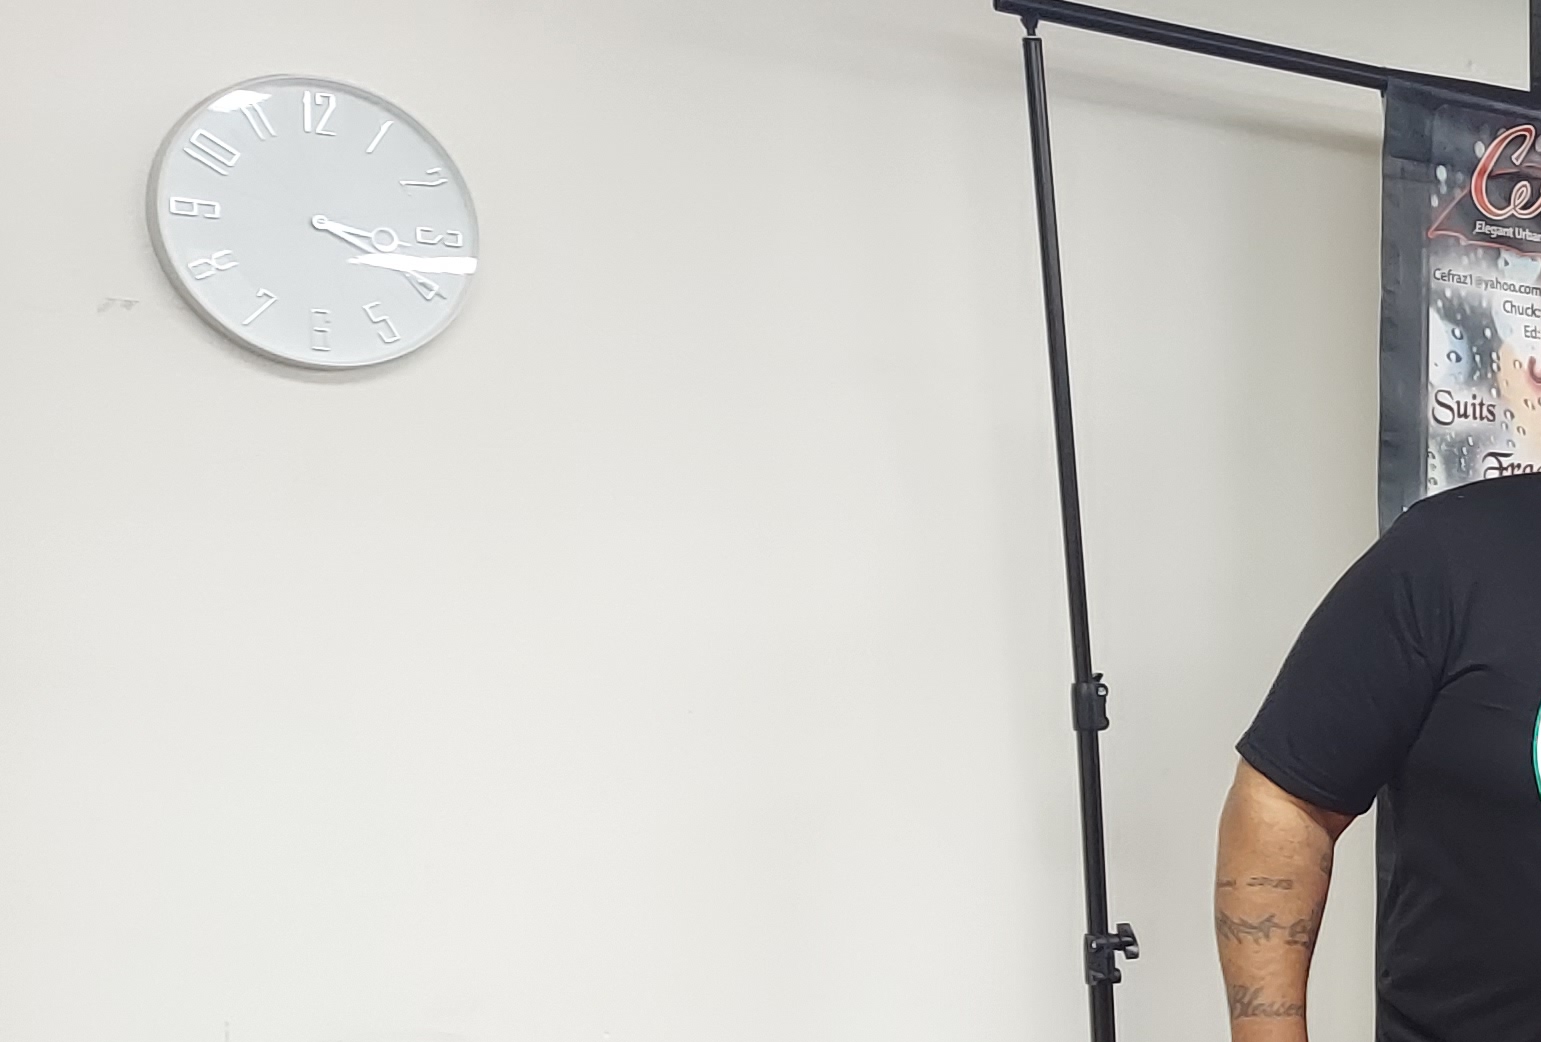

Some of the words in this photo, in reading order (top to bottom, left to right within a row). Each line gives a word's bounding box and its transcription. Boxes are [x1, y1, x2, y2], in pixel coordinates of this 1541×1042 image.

[302, 90, 336, 137] 12
[184, 128, 240, 176] 10
[366, 120, 393, 153] 1
[170, 197, 221, 219] 9
[416, 227, 463, 247] 3
[1475, 221, 1514, 239] Elegant
[188, 249, 239, 279] 8
[242, 289, 277, 325] 7
[362, 301, 401, 343] 5
[1524, 326, 1541, 340] Ed:
[1431, 389, 1497, 425] Suits
